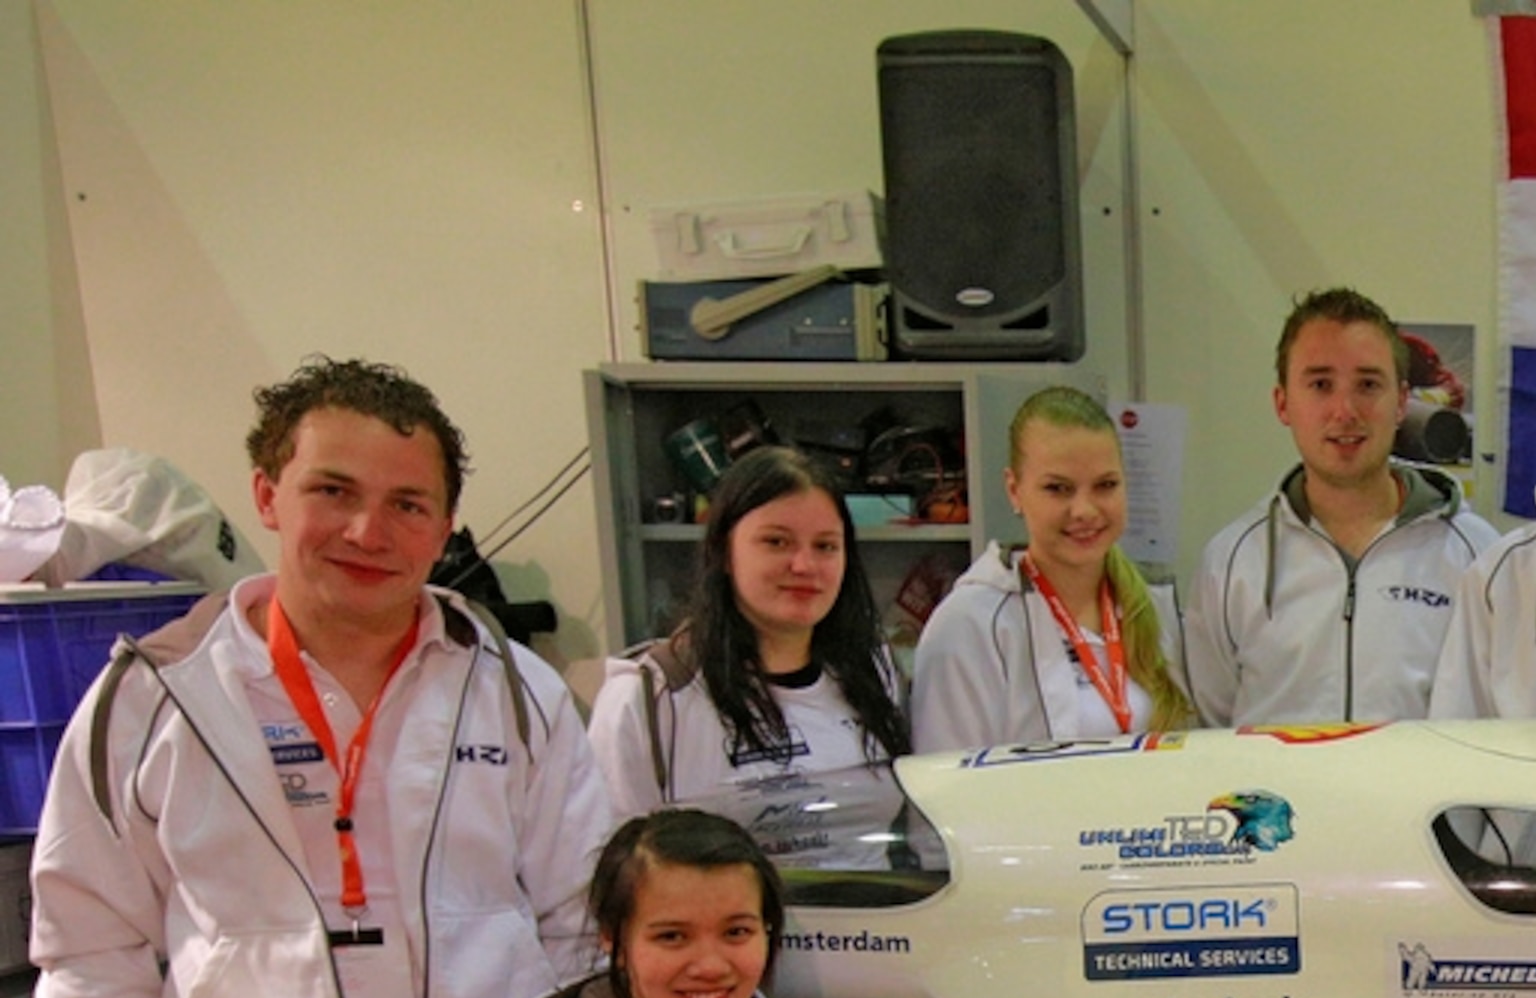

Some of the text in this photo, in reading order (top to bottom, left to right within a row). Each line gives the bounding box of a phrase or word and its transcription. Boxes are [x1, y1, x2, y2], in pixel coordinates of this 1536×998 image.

[1103, 899, 1265, 933] STORK
[779, 930, 910, 953] msterdam
[1095, 947, 1290, 970] TECHNICAL SERVICES
